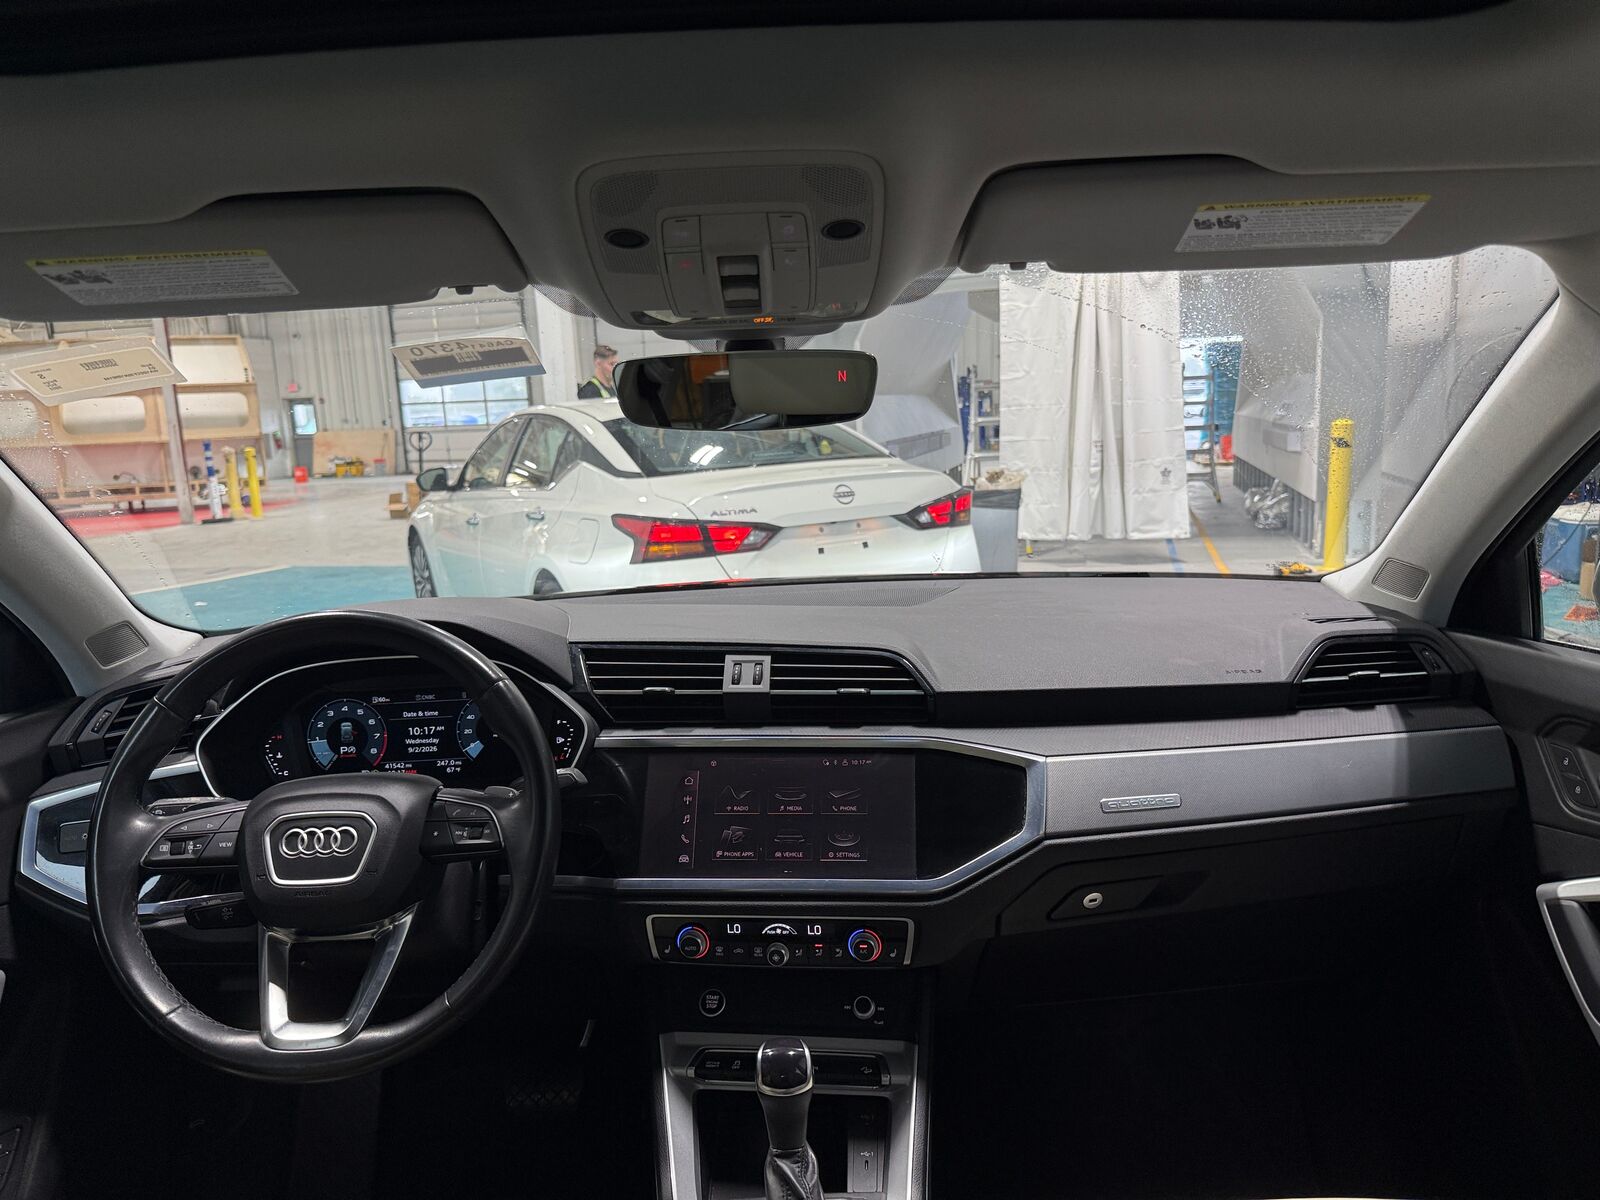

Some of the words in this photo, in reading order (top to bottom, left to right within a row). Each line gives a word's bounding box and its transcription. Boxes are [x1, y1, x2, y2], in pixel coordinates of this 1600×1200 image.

[837, 370, 847, 382] N
[710, 508, 758, 517] ALTIMA
[408, 726, 435, 736] 10:17
[726, 924, 741, 934] LO
[807, 925, 822, 935] LO
